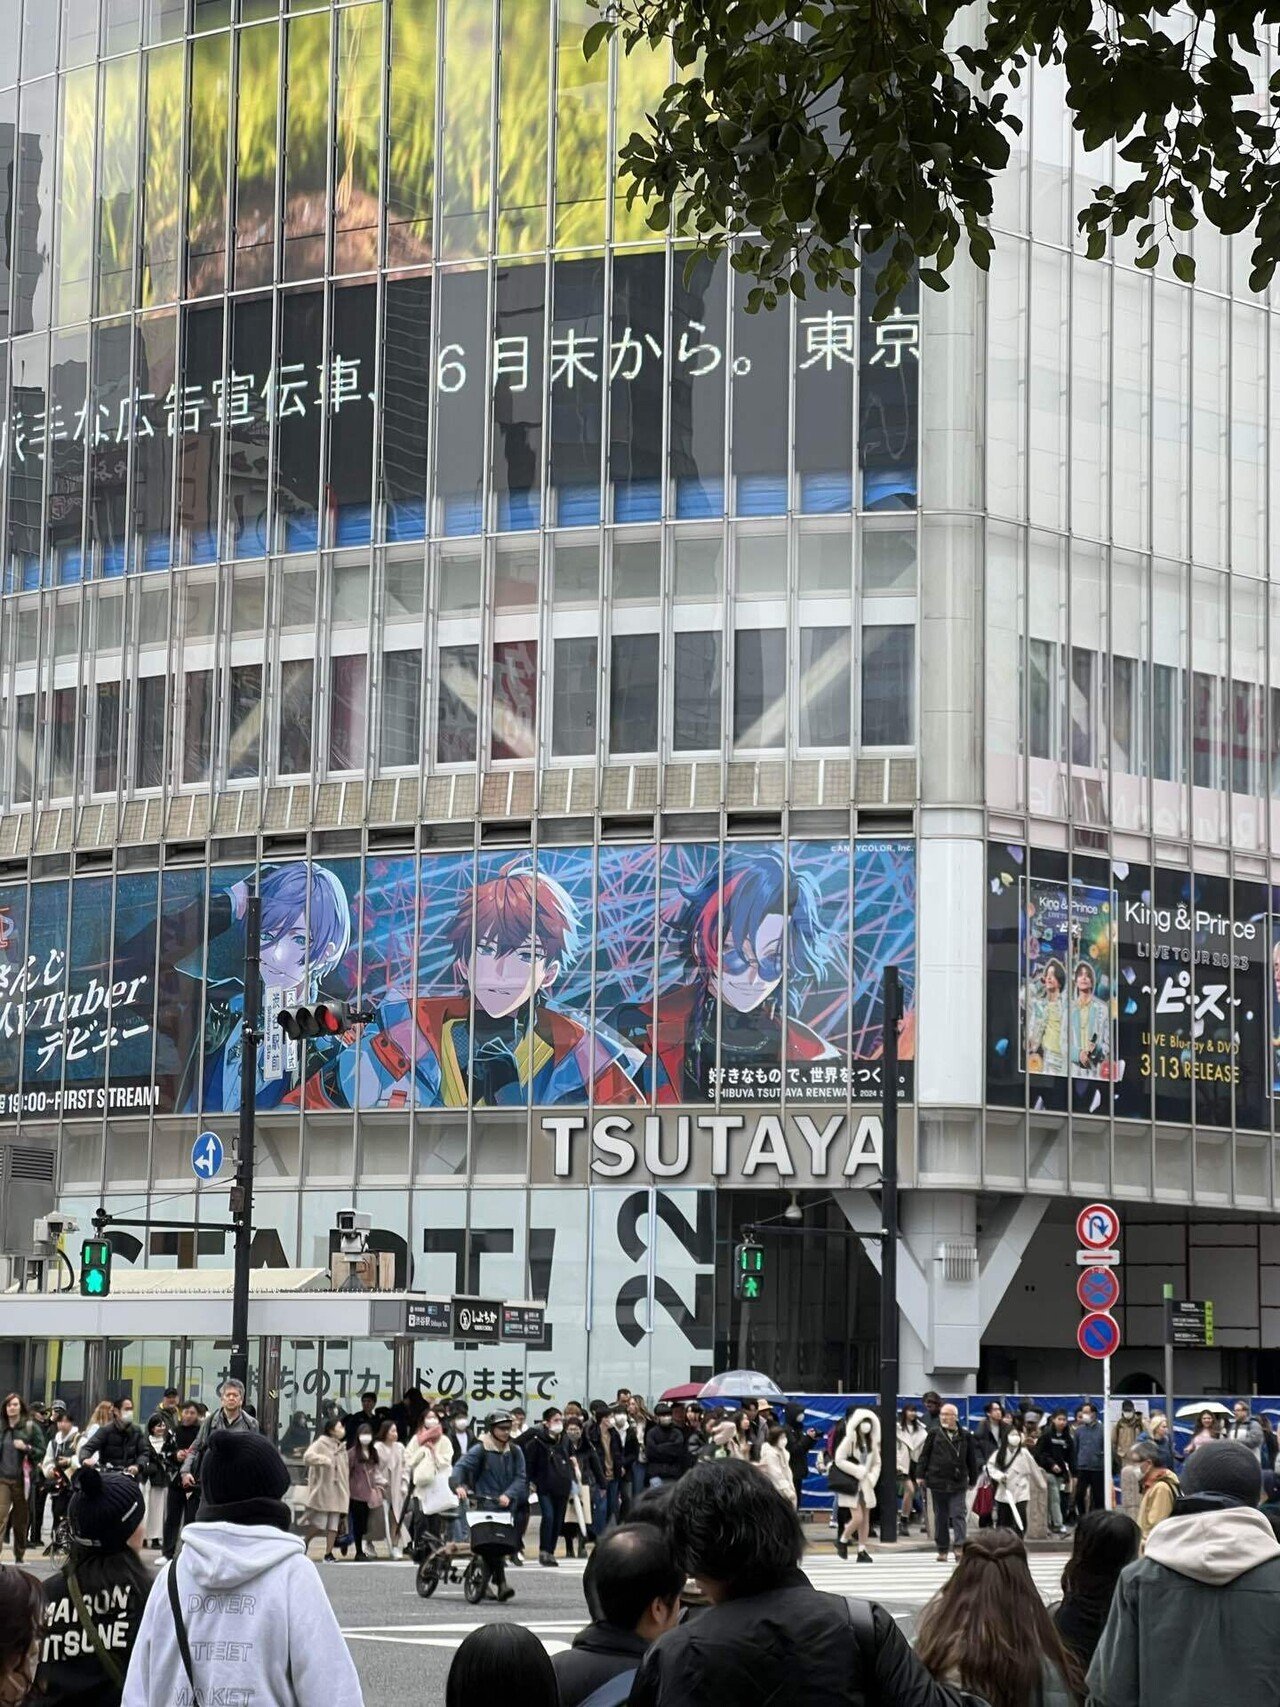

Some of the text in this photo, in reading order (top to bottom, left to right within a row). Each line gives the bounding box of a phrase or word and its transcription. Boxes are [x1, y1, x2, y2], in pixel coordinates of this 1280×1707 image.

[1124, 900, 1256, 940] King & Prince
[1137, 941, 1250, 972] LIVE TOUR 2023
[1142, 1031, 1240, 1055] LIVE Blu-ray & DVD
[708, 1066, 906, 1085] 好きなもので、世界をつく。
[1140, 1053, 1241, 1084] 3.13 RELEASE
[96, 1084, 160, 1108] STREAM
[708, 1087, 755, 1098] SHIBUYA
[757, 1087, 803, 1098] TSUTAYA
[541, 1113, 885, 1178] TSUTAYA
